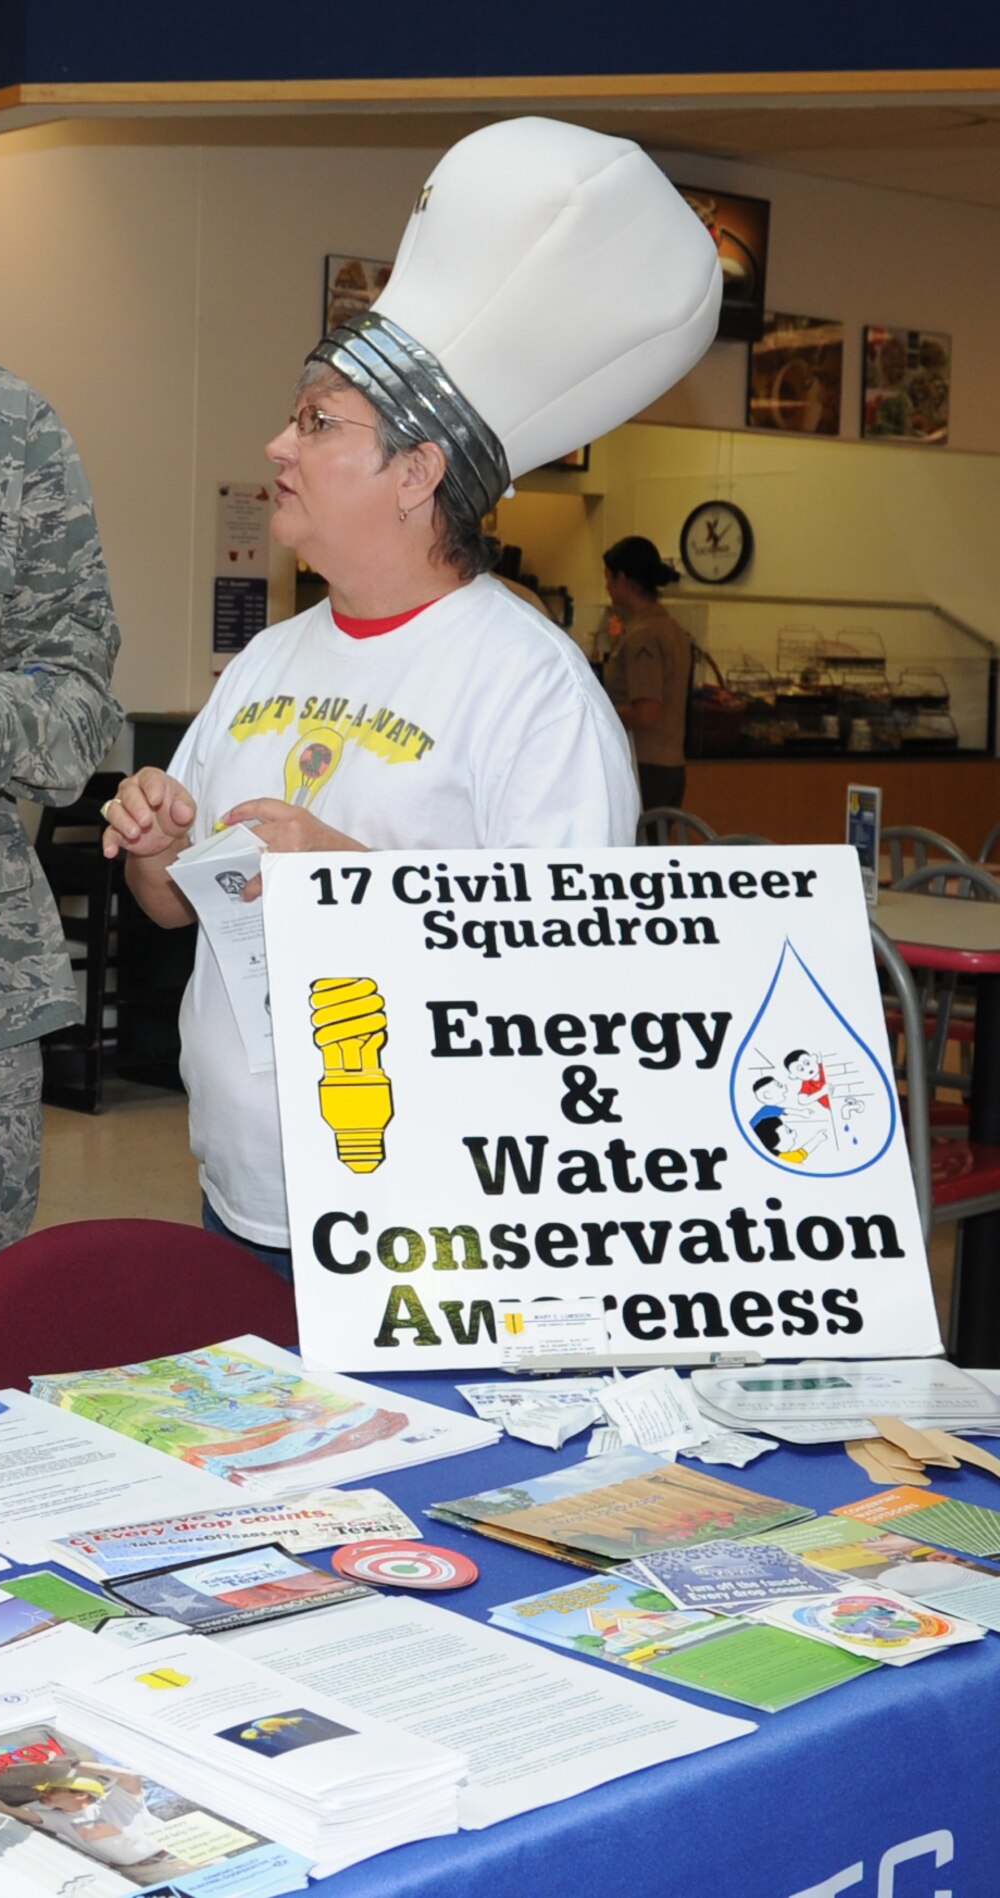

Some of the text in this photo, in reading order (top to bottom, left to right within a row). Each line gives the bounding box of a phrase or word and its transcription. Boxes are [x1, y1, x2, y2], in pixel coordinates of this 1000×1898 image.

[310, 859, 817, 913] 17 Civil Engineer
[423, 907, 720, 959] Squadron
[425, 1000, 731, 1076] Energy
[560, 1064, 623, 1125] &
[462, 1135, 728, 1196] Water
[312, 1198, 905, 1275] Conservation
[85, 1514, 207, 1536] Conserve
[93, 1509, 334, 1542] Every drop counts.
[333, 1522, 403, 1536] Texas
[222, 1569, 287, 1588] Texas
[683, 1583, 711, 1593] Turn
[714, 1581, 736, 1592] off
[738, 1579, 760, 1590] the
[687, 1591, 729, 1602] Every
[732, 1587, 766, 1600] drop
